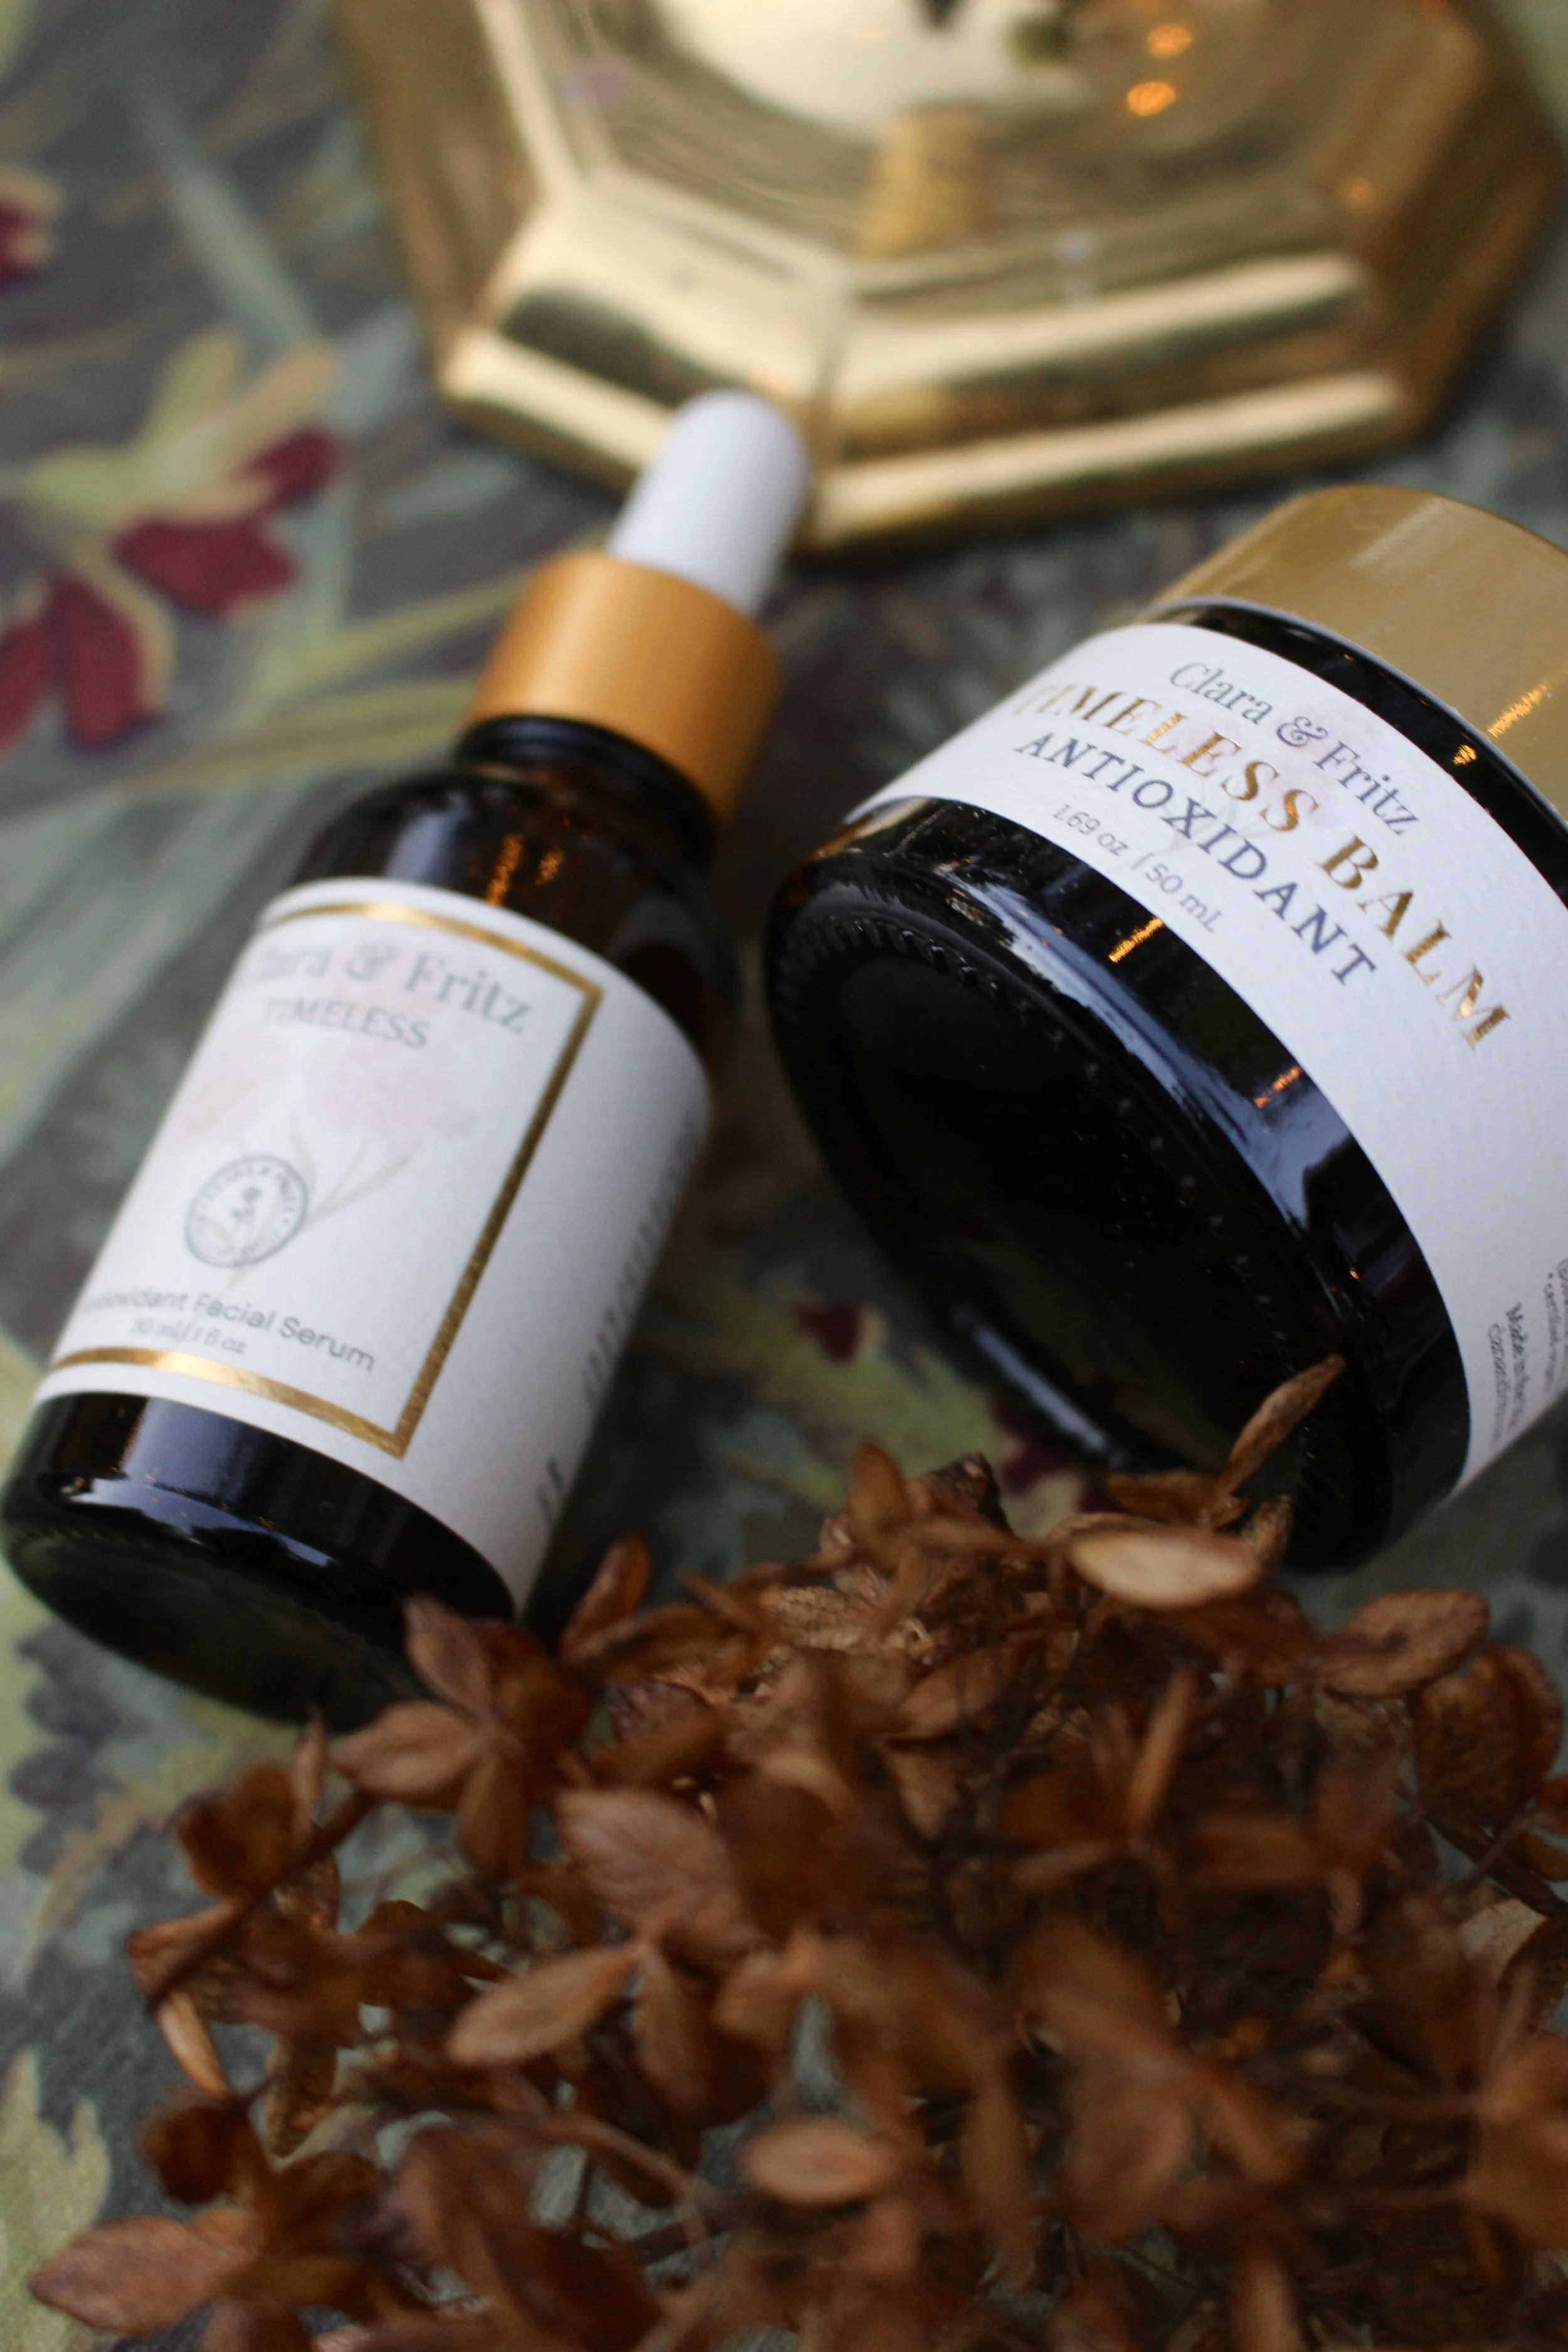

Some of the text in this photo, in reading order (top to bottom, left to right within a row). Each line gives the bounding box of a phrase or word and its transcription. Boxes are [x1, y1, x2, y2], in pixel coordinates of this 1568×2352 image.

[1170, 662, 1419, 836] Clara & Fritz
[1012, 684, 1512, 1050] TIMELESS BALM
[1013, 732, 1376, 987] ANTIOXIDANT
[1096, 833, 1128, 857] oz
[402, 951, 532, 1036] Fritz
[193, 1292, 277, 1332] Facial
[277, 1315, 378, 1374] Serum
